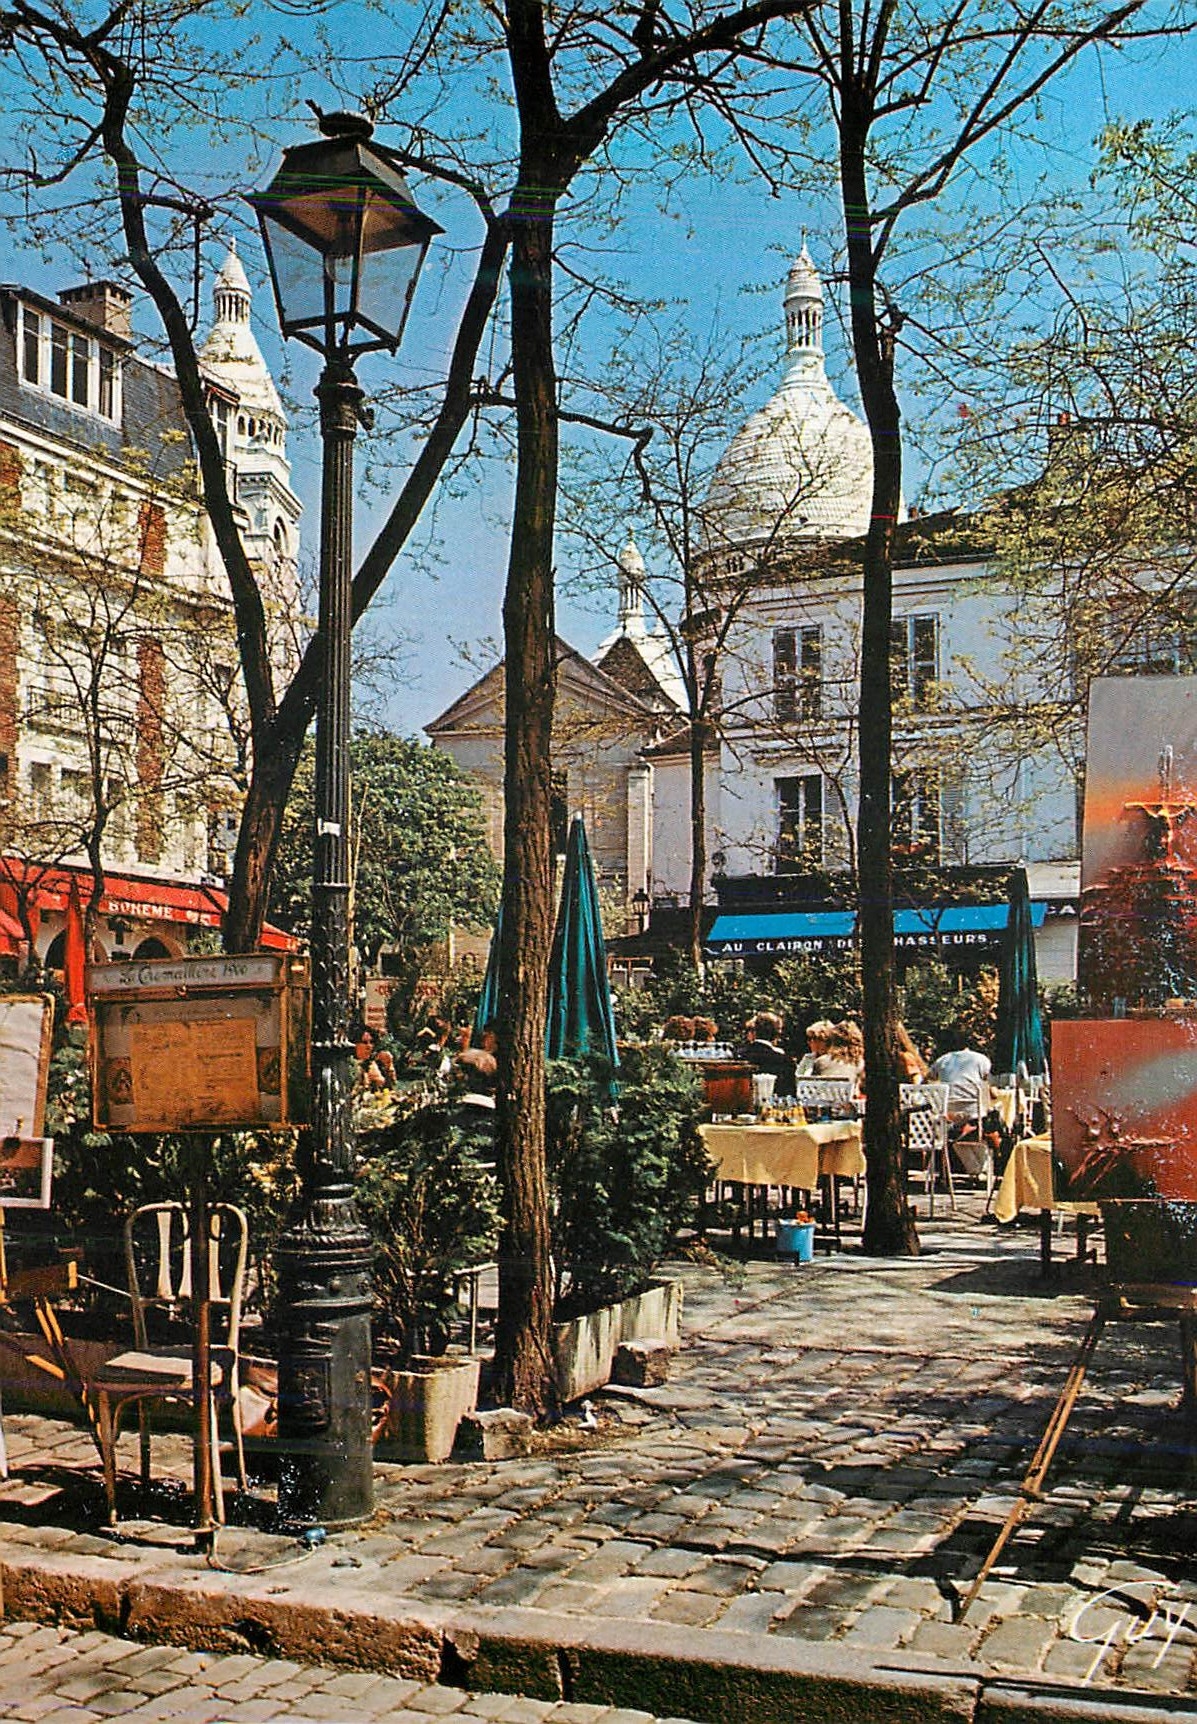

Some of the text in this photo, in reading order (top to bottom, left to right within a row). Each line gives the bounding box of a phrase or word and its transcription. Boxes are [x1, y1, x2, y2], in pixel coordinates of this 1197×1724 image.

[722, 942, 743, 952] AU
[756, 939, 823, 951] CLAIRON
[893, 934, 987, 946] HASSEURS
